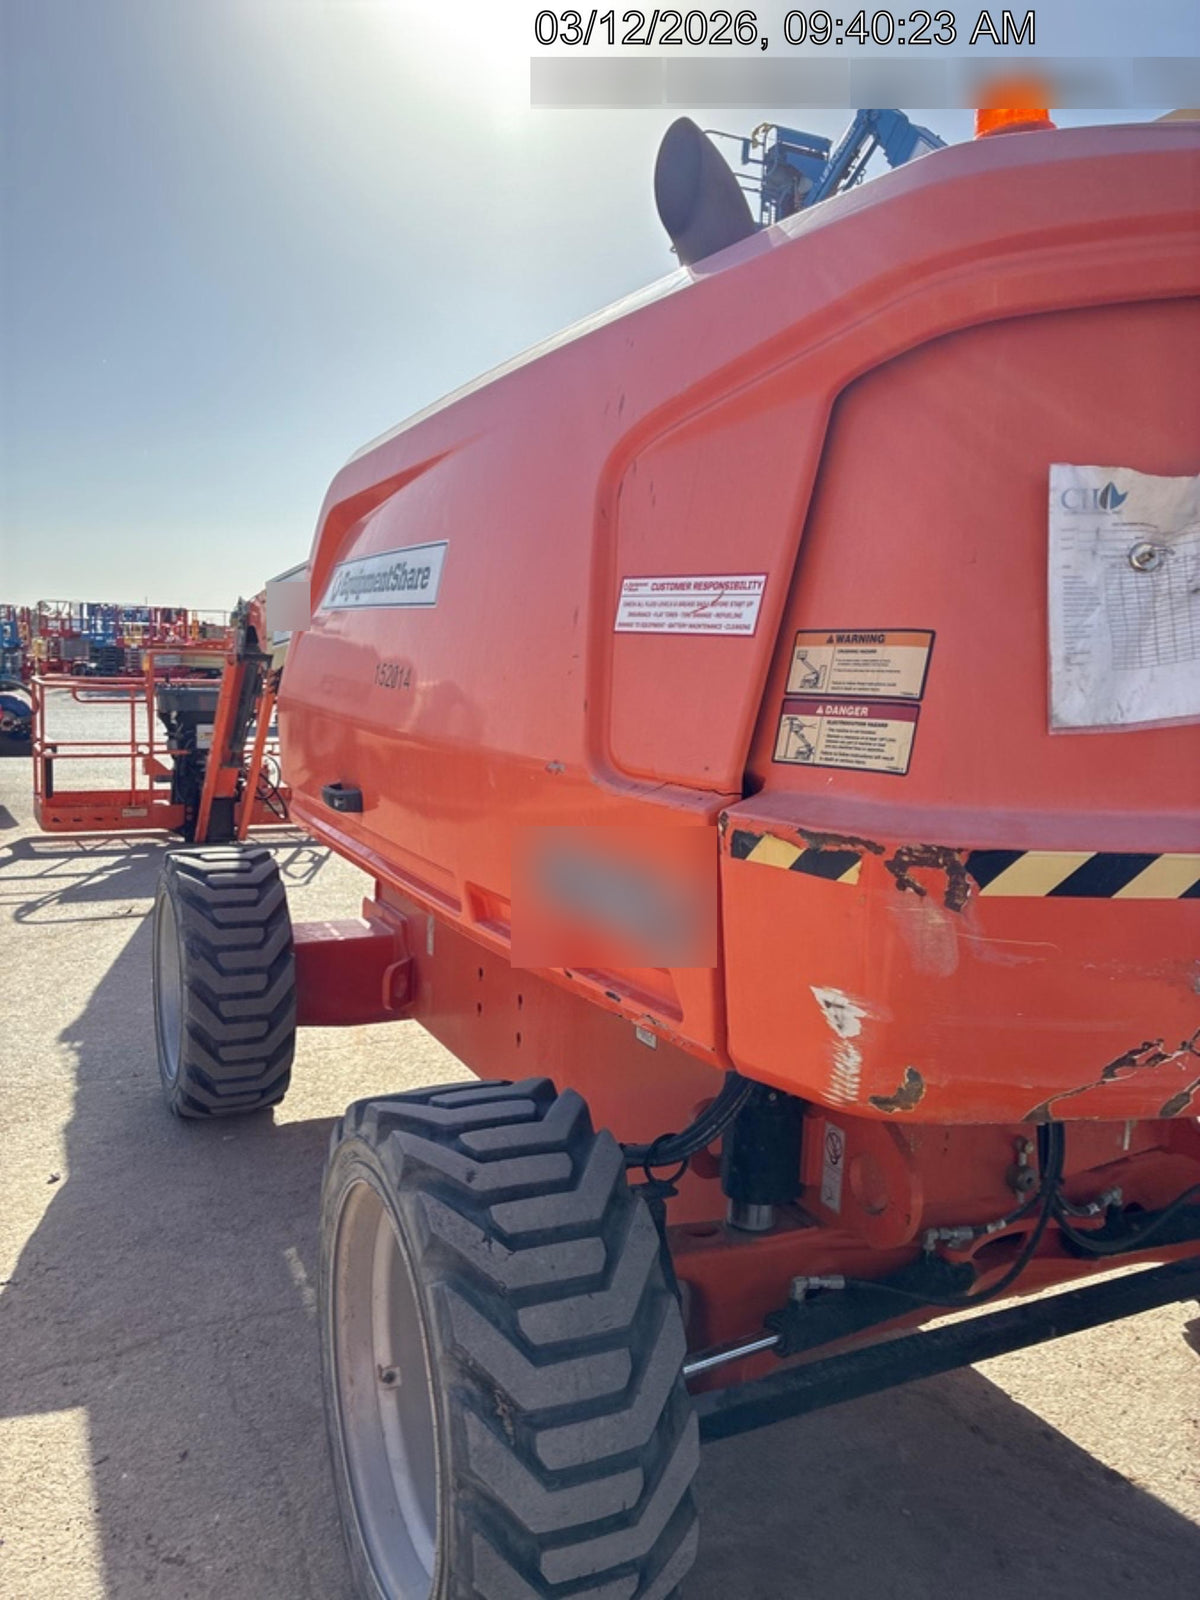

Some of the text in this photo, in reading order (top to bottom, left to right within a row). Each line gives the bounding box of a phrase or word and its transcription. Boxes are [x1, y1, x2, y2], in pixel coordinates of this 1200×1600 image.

[650, 582, 692, 591] CUSTOMER
[693, 580, 763, 591] RESPONSIBILITY
[834, 634, 885, 644] WARNING
[825, 705, 869, 716] DANGER
